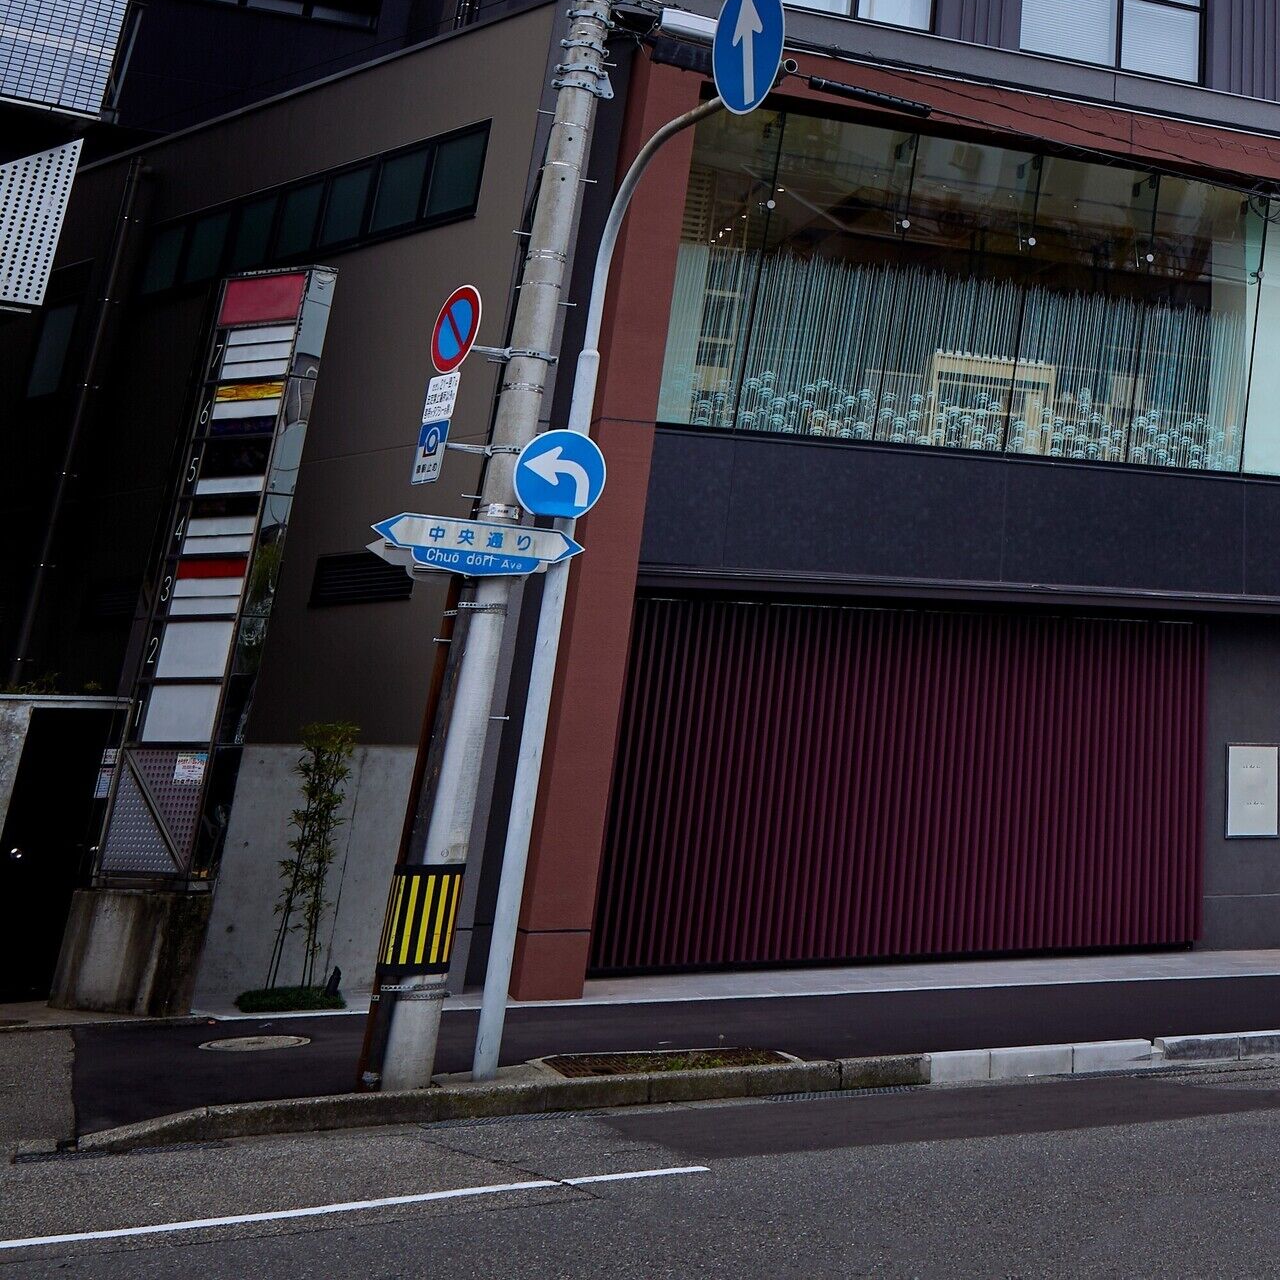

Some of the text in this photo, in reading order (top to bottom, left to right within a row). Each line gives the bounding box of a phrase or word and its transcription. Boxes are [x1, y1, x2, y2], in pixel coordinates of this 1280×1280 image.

[212, 344, 224, 368] 7
[200, 400, 211, 425] 6
[186, 457, 199, 482] 5
[175, 516, 186, 541] 4
[428, 526, 531, 551] 中央通り
[500, 559, 523, 570] Ave
[160, 576, 172, 601] 3
[146, 637, 159, 663] 2
[134, 700, 143, 727] 1
